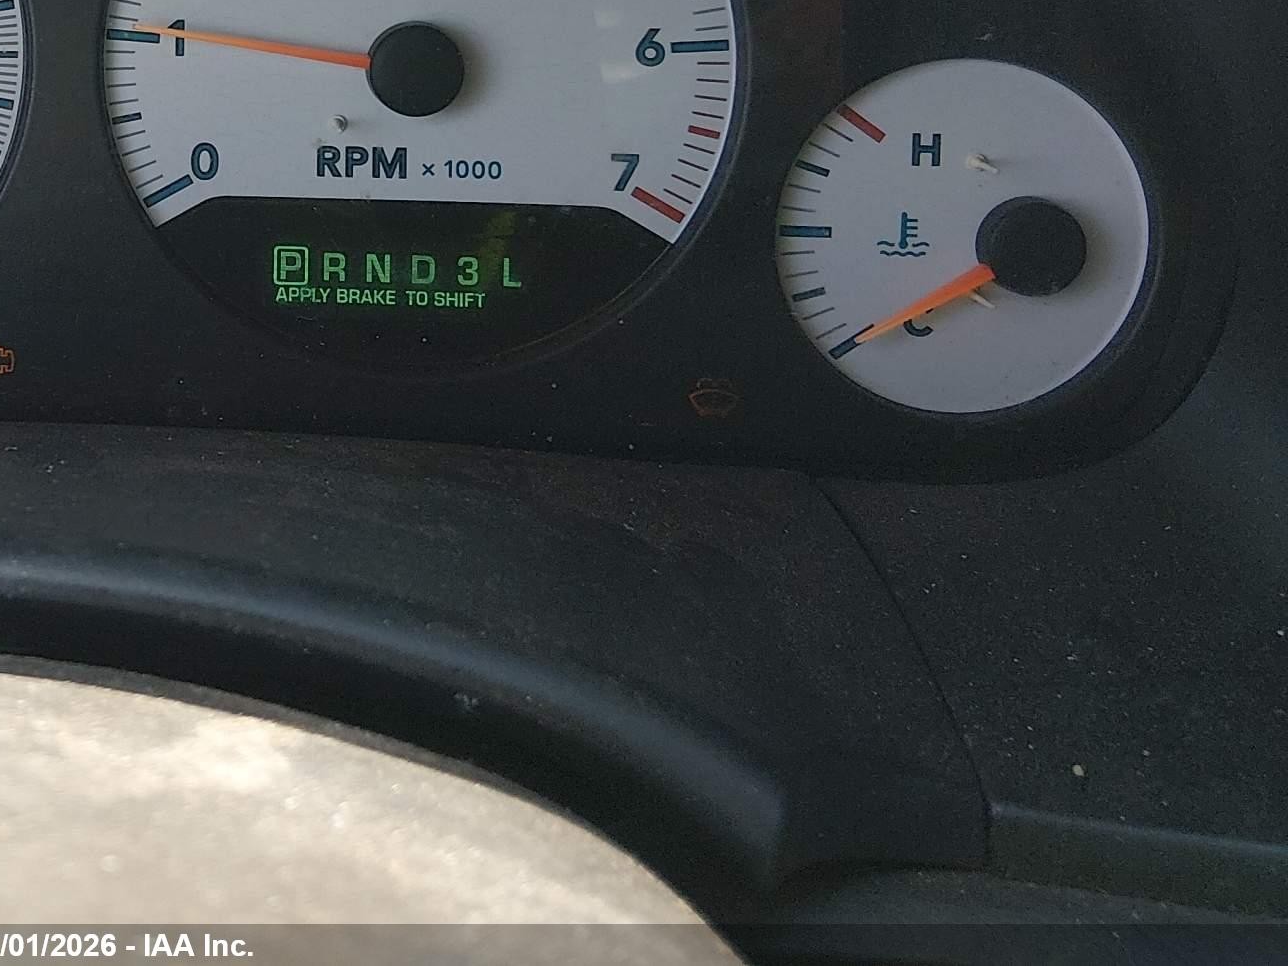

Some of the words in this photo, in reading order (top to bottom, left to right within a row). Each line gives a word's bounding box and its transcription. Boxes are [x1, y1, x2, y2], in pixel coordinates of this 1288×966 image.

[168, 20, 185, 56] 1
[636, 28, 665, 67] 6
[191, 143, 219, 180] 0
[317, 146, 407, 179] RPM
[444, 160, 501, 179] 1000
[912, 133, 941, 166] H
[611, 154, 639, 191] 7
[279, 251, 302, 280] P
[324, 253, 345, 281] R
[367, 254, 390, 282] N
[412, 254, 435, 284] D
[458, 257, 478, 285] 3
[504, 258, 521, 287] L
[275, 287, 331, 304] APPLY
[336, 288, 396, 305] BRAKE
[406, 290, 428, 306] TO
[434, 291, 486, 308] SHIFT
